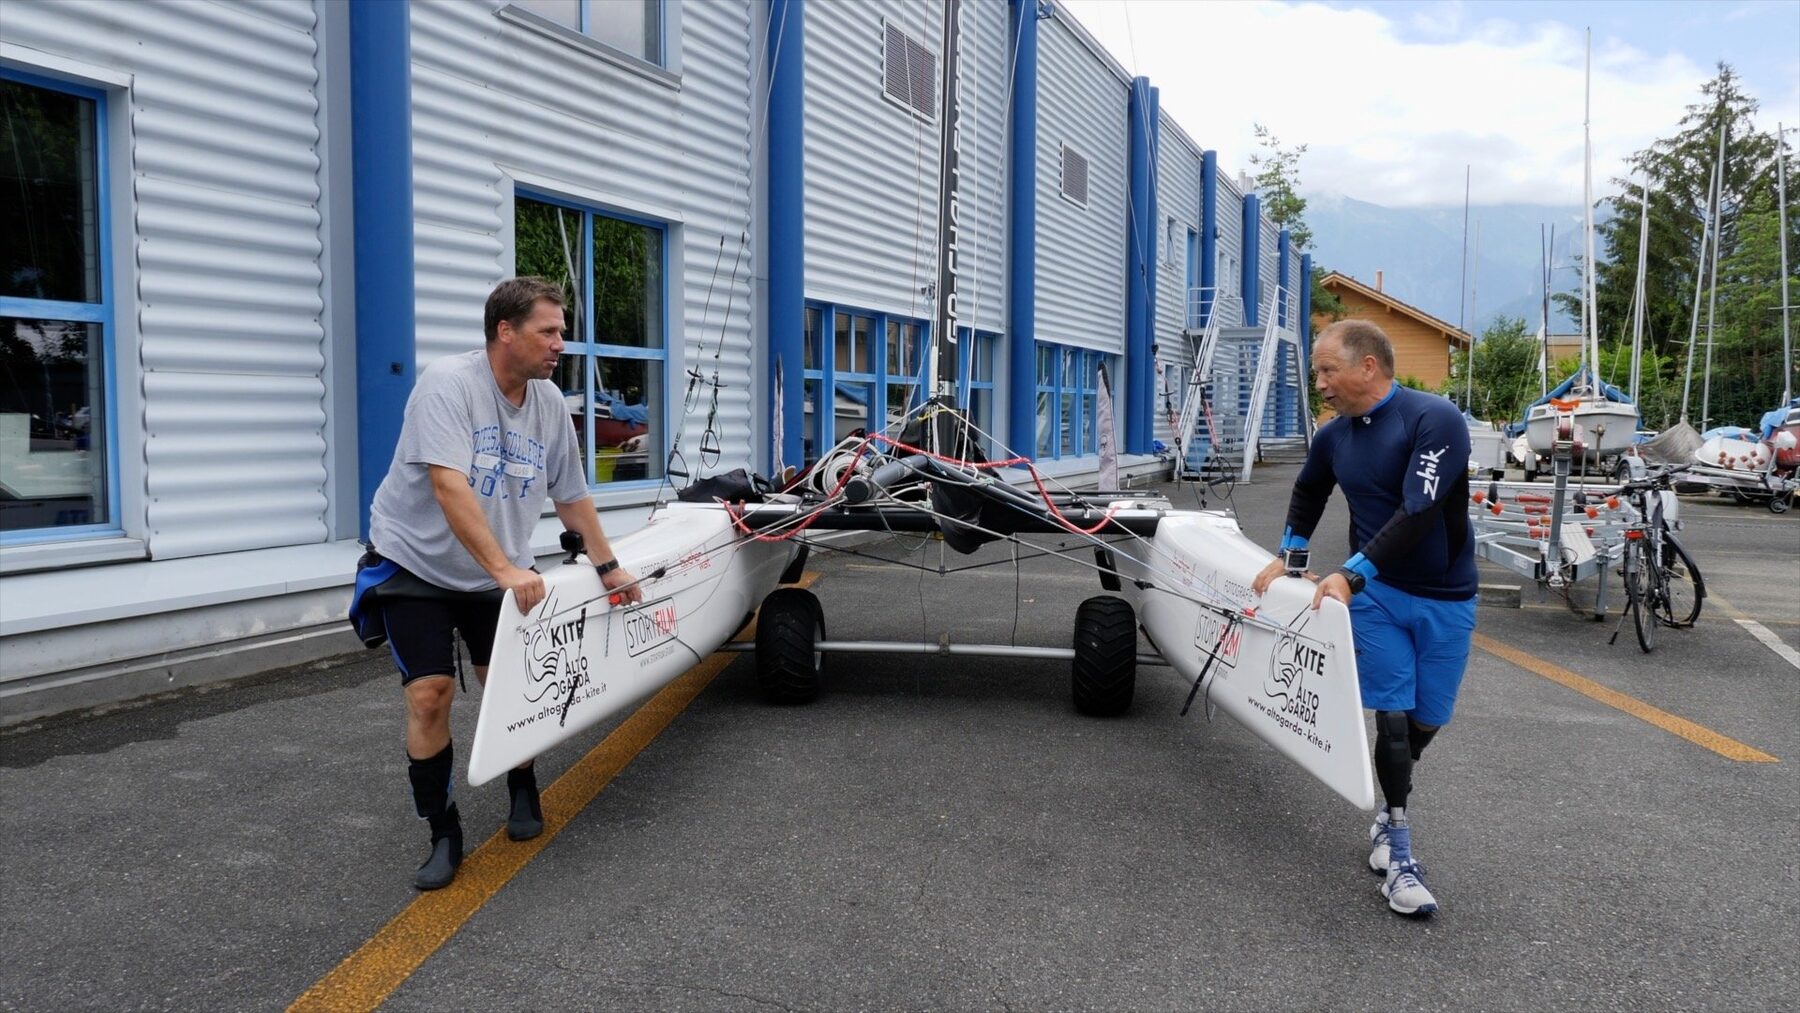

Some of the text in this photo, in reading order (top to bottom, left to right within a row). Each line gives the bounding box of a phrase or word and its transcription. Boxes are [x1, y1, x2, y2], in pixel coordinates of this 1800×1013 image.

[1416, 446, 1448, 501] zhik
[551, 619, 584, 648] KITE
[565, 656, 588, 678] ALTO
[1294, 642, 1326, 677] KITE
[560, 671, 591, 695] GARDA
[507, 682, 607, 733] www.altogada-kite.it
[1288, 698, 1316, 728] GARDA
[1296, 686, 1319, 711] ALTO
[1248, 696, 1331, 754] www.altogarda-kite.it
